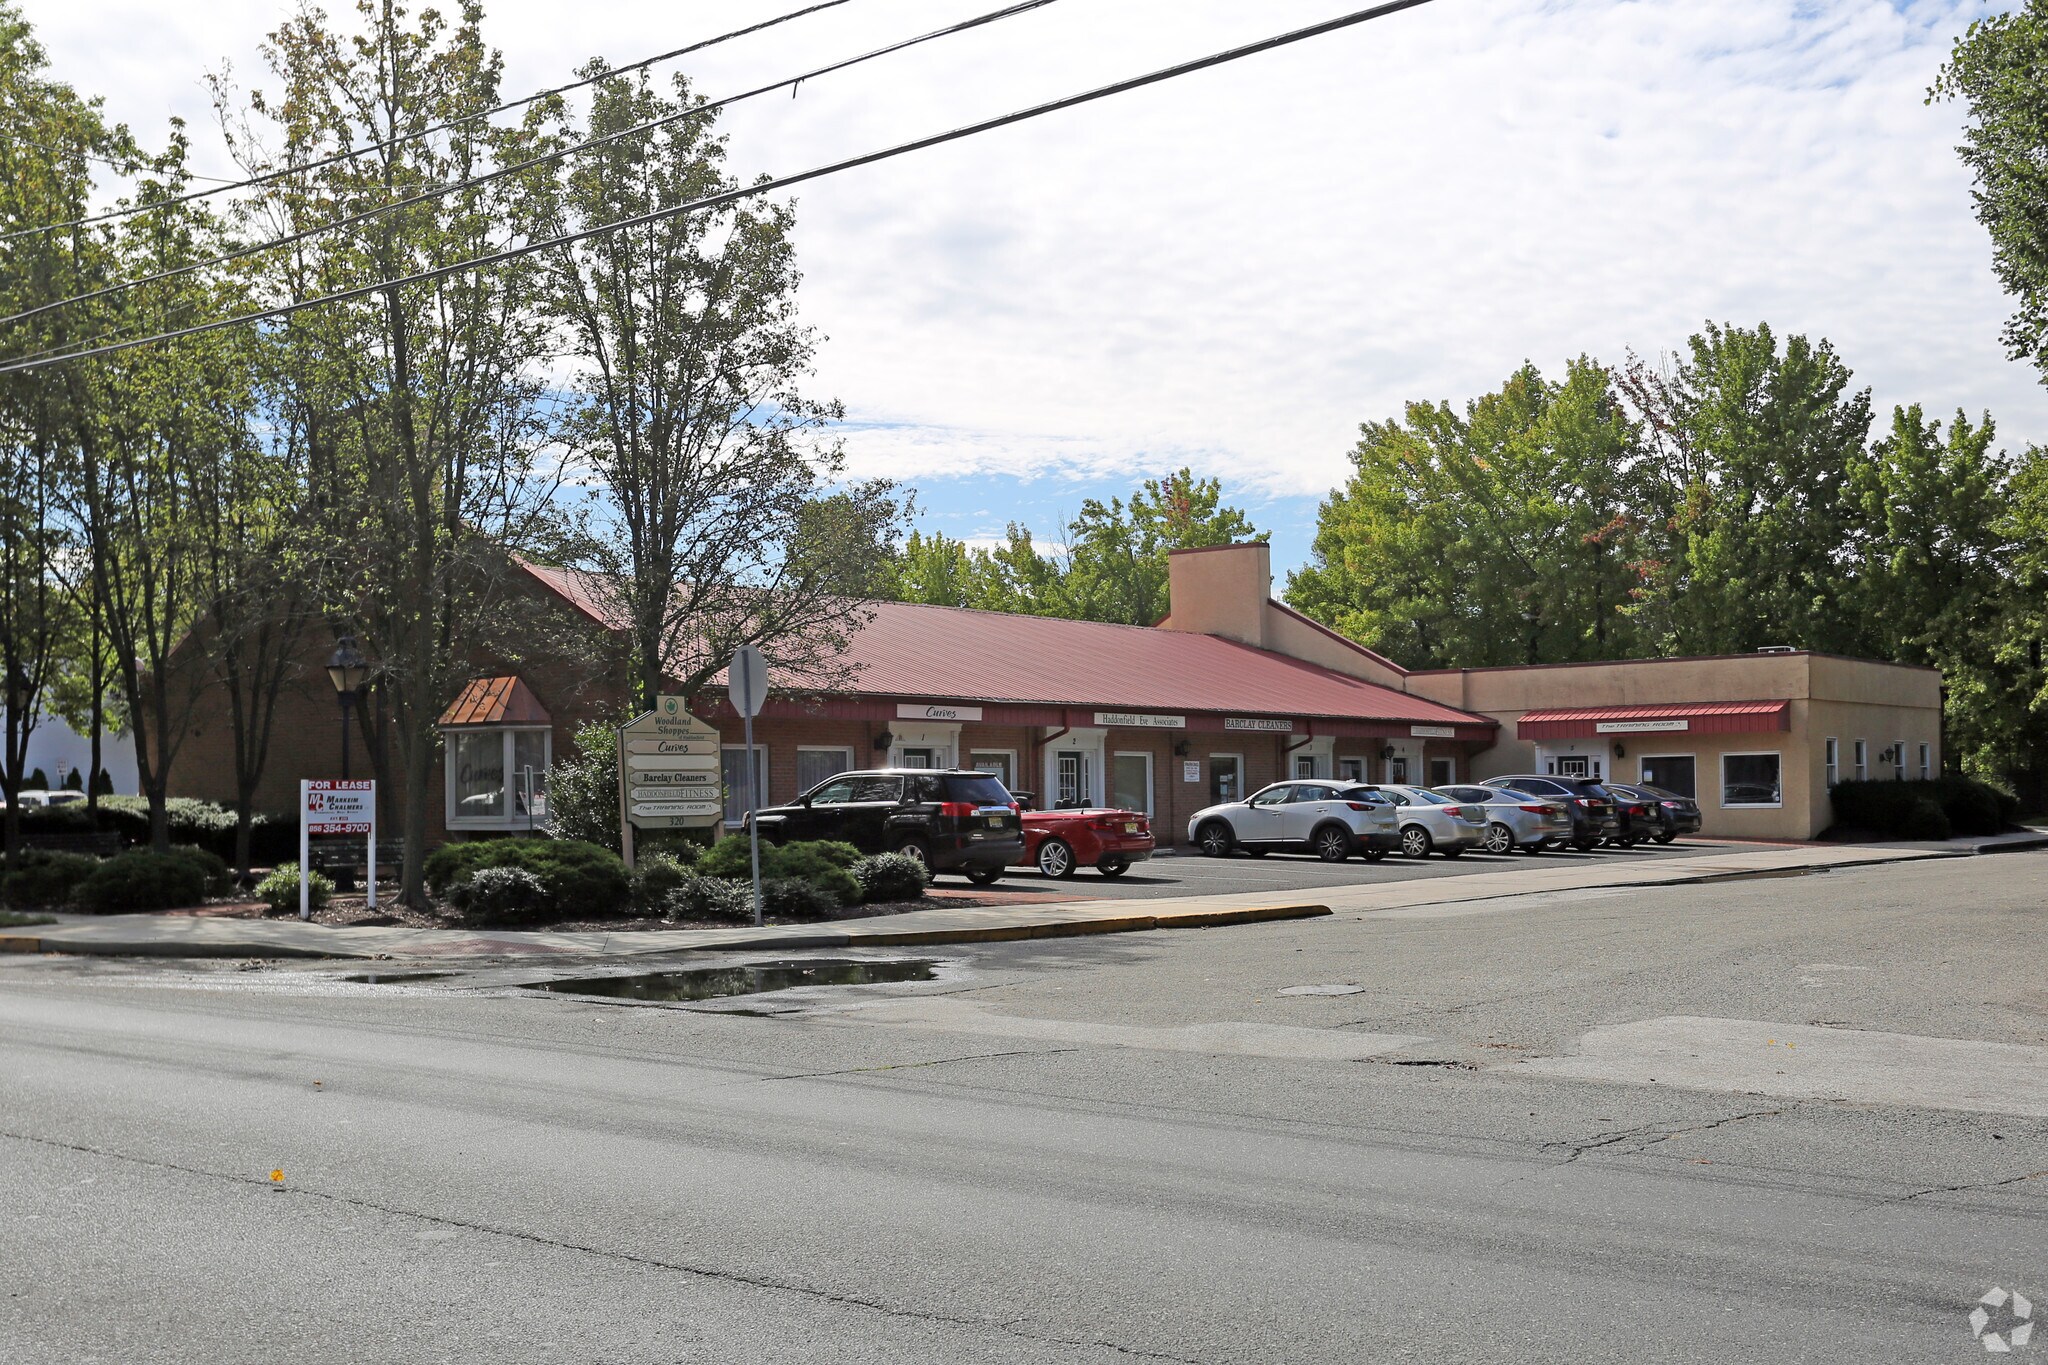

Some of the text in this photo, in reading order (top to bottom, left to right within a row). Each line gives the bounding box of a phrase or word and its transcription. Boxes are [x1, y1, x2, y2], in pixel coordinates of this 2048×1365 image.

[926, 706, 956, 719] Curves
[655, 717, 692, 726] Woodland
[1103, 714, 1135, 725] Haddonfield
[1153, 717, 1178, 726] Associates
[1226, 719, 1292, 730] BARCLAY CLEANERS
[658, 726, 690, 736] Shoppes
[658, 741, 688, 753] Curves
[643, 773, 707, 783] Barclay Cleaners
[308, 781, 370, 789] FOR LEASE
[669, 816, 685, 826] 320
[323, 823, 369, 833] 354-9700
